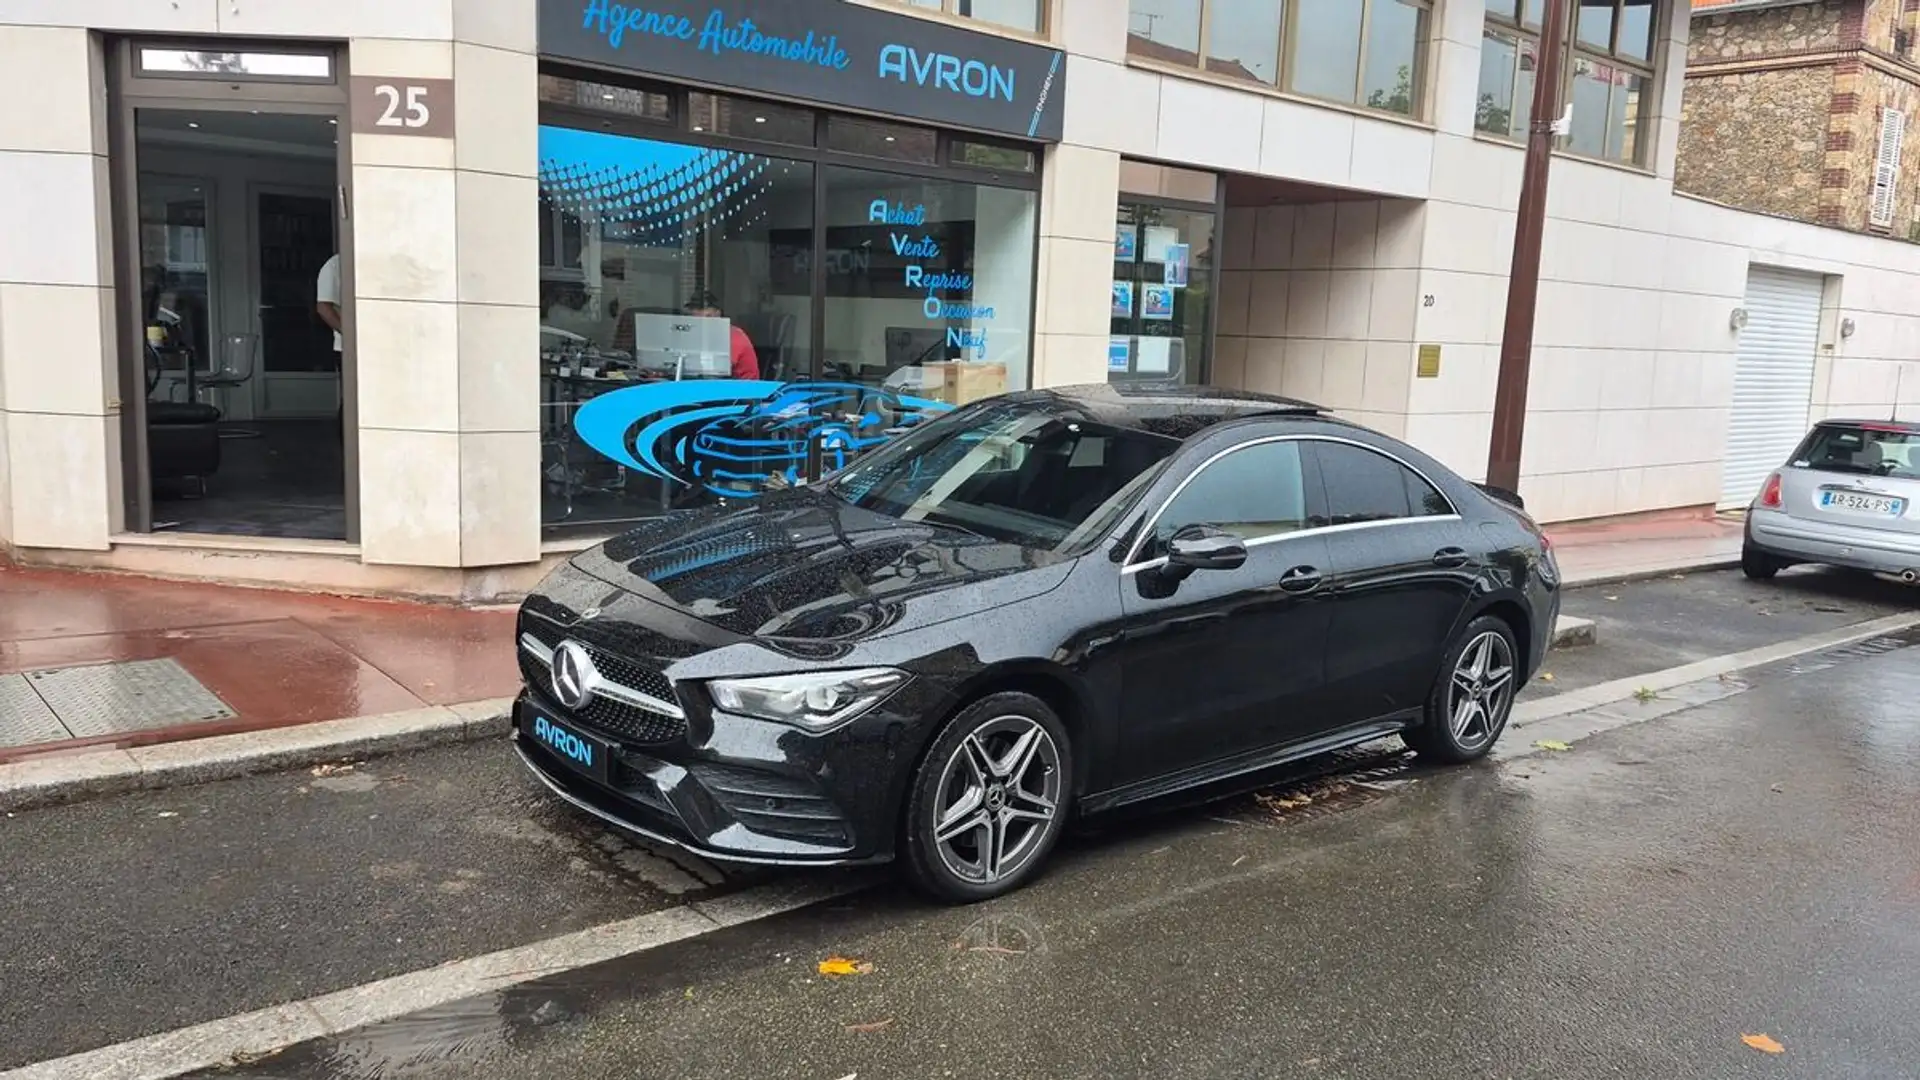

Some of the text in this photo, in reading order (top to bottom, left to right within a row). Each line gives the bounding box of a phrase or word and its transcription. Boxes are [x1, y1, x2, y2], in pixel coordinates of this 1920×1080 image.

[583, 0, 850, 69] Agence Automobile
[879, 43, 1015, 102] AVRON
[374, 85, 430, 128] 25
[869, 199, 926, 226] Achat
[890, 232, 940, 257] Vente
[905, 265, 973, 296] Reprise
[923, 296, 996, 319] Occasion
[946, 326, 988, 359] Neuf
[535, 716, 592, 767] AVRON
